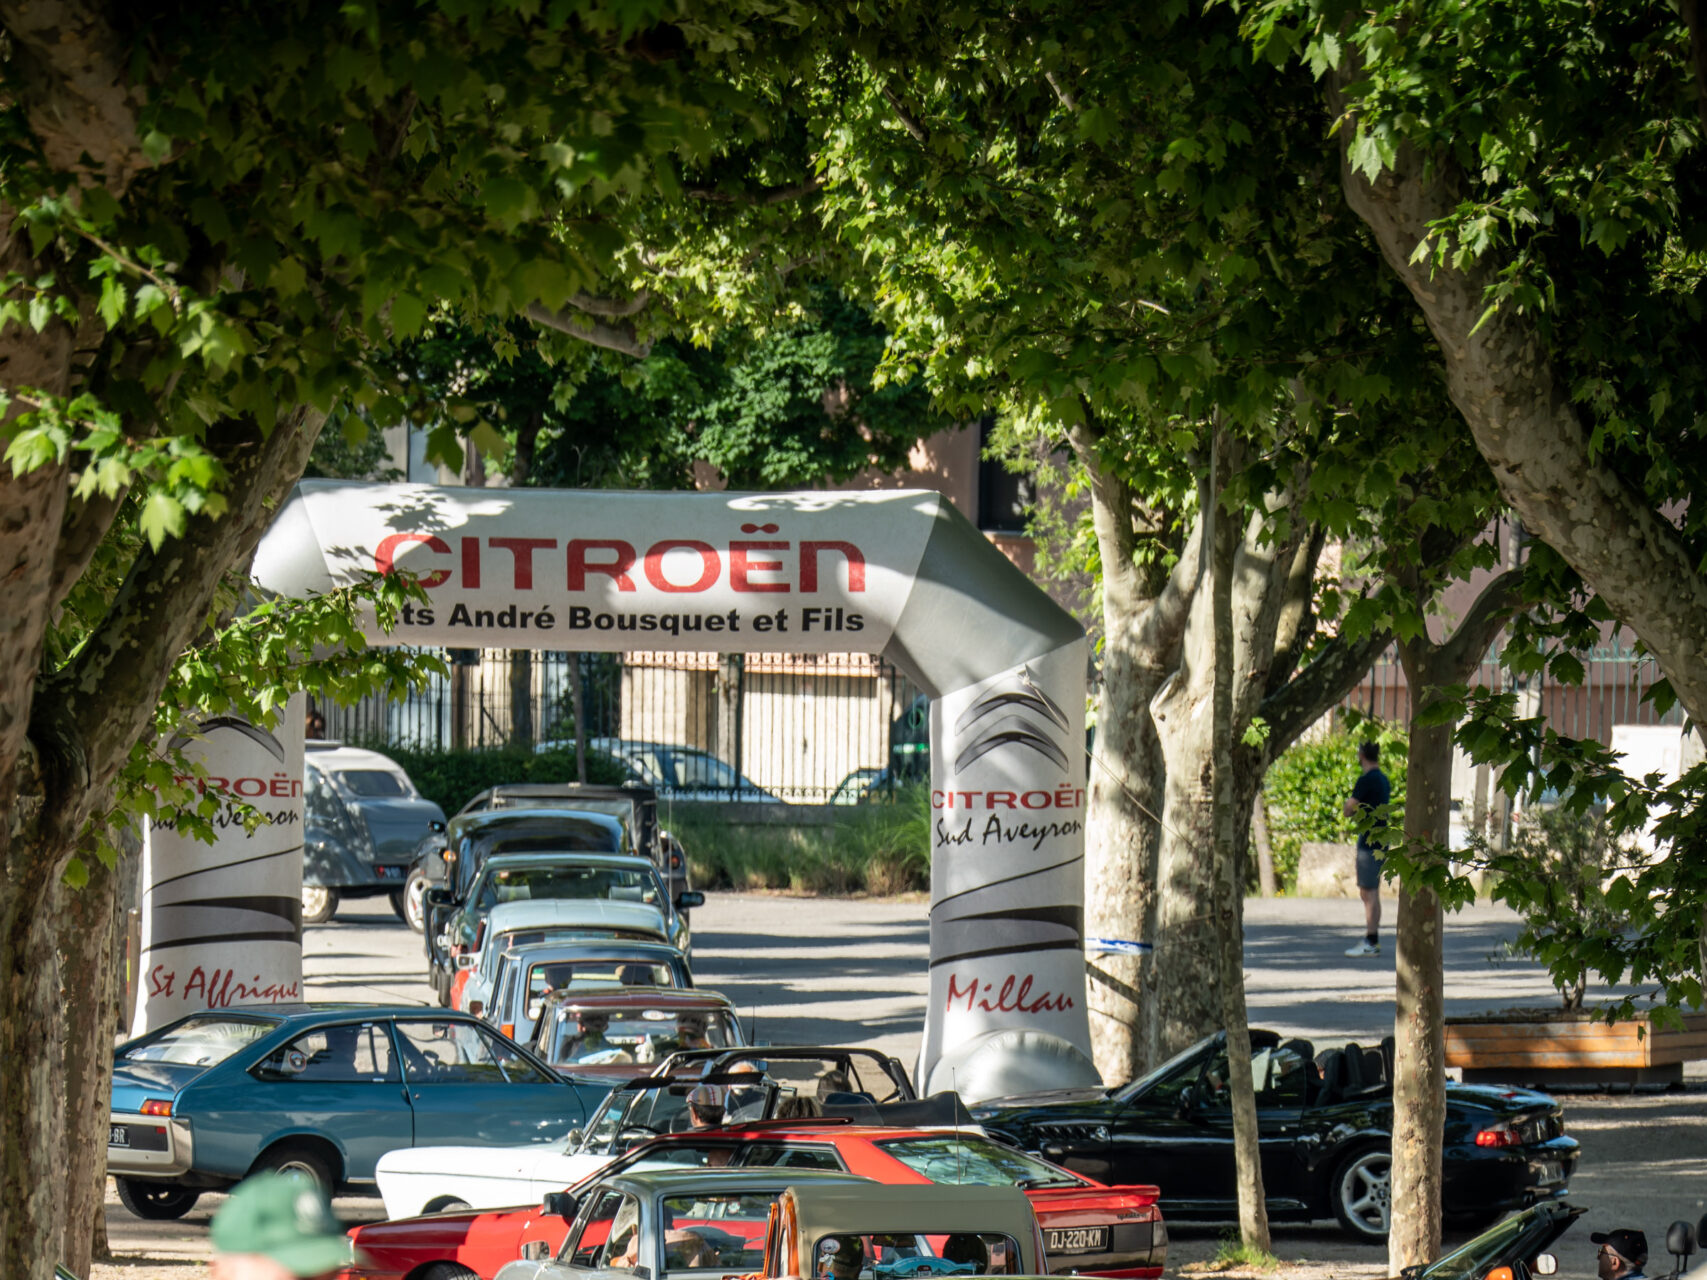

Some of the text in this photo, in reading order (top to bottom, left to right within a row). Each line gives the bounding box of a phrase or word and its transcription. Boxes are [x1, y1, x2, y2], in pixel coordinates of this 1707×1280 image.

[394, 604, 865, 636] ts André Bousquet et Fils
[936, 813, 1082, 851] Sud Aveyron
[150, 964, 298, 1009] St Affrique
[947, 973, 1075, 1015] Millau
